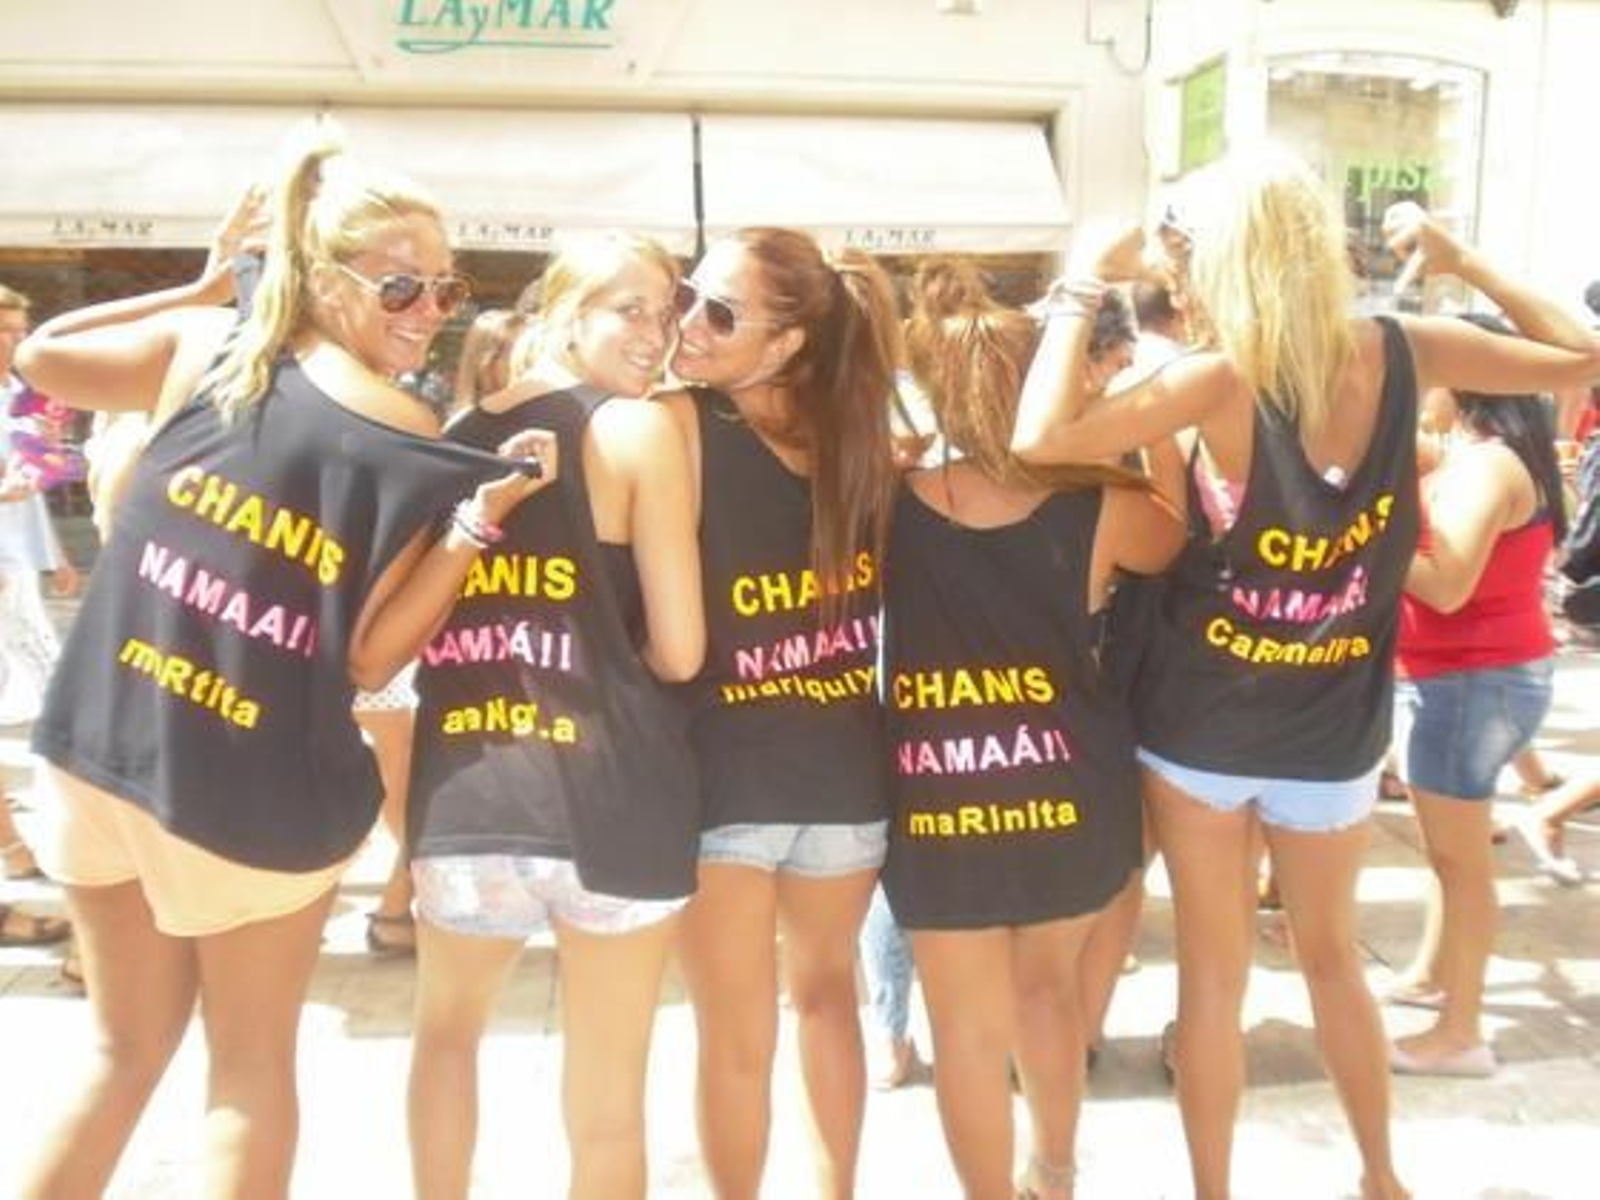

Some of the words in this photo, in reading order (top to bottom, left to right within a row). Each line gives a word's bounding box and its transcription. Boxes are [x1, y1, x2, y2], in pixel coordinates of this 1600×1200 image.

[166, 466, 344, 586] CHANIS
[1257, 494, 1394, 571] CHNS
[456, 554, 577, 600] ANIS
